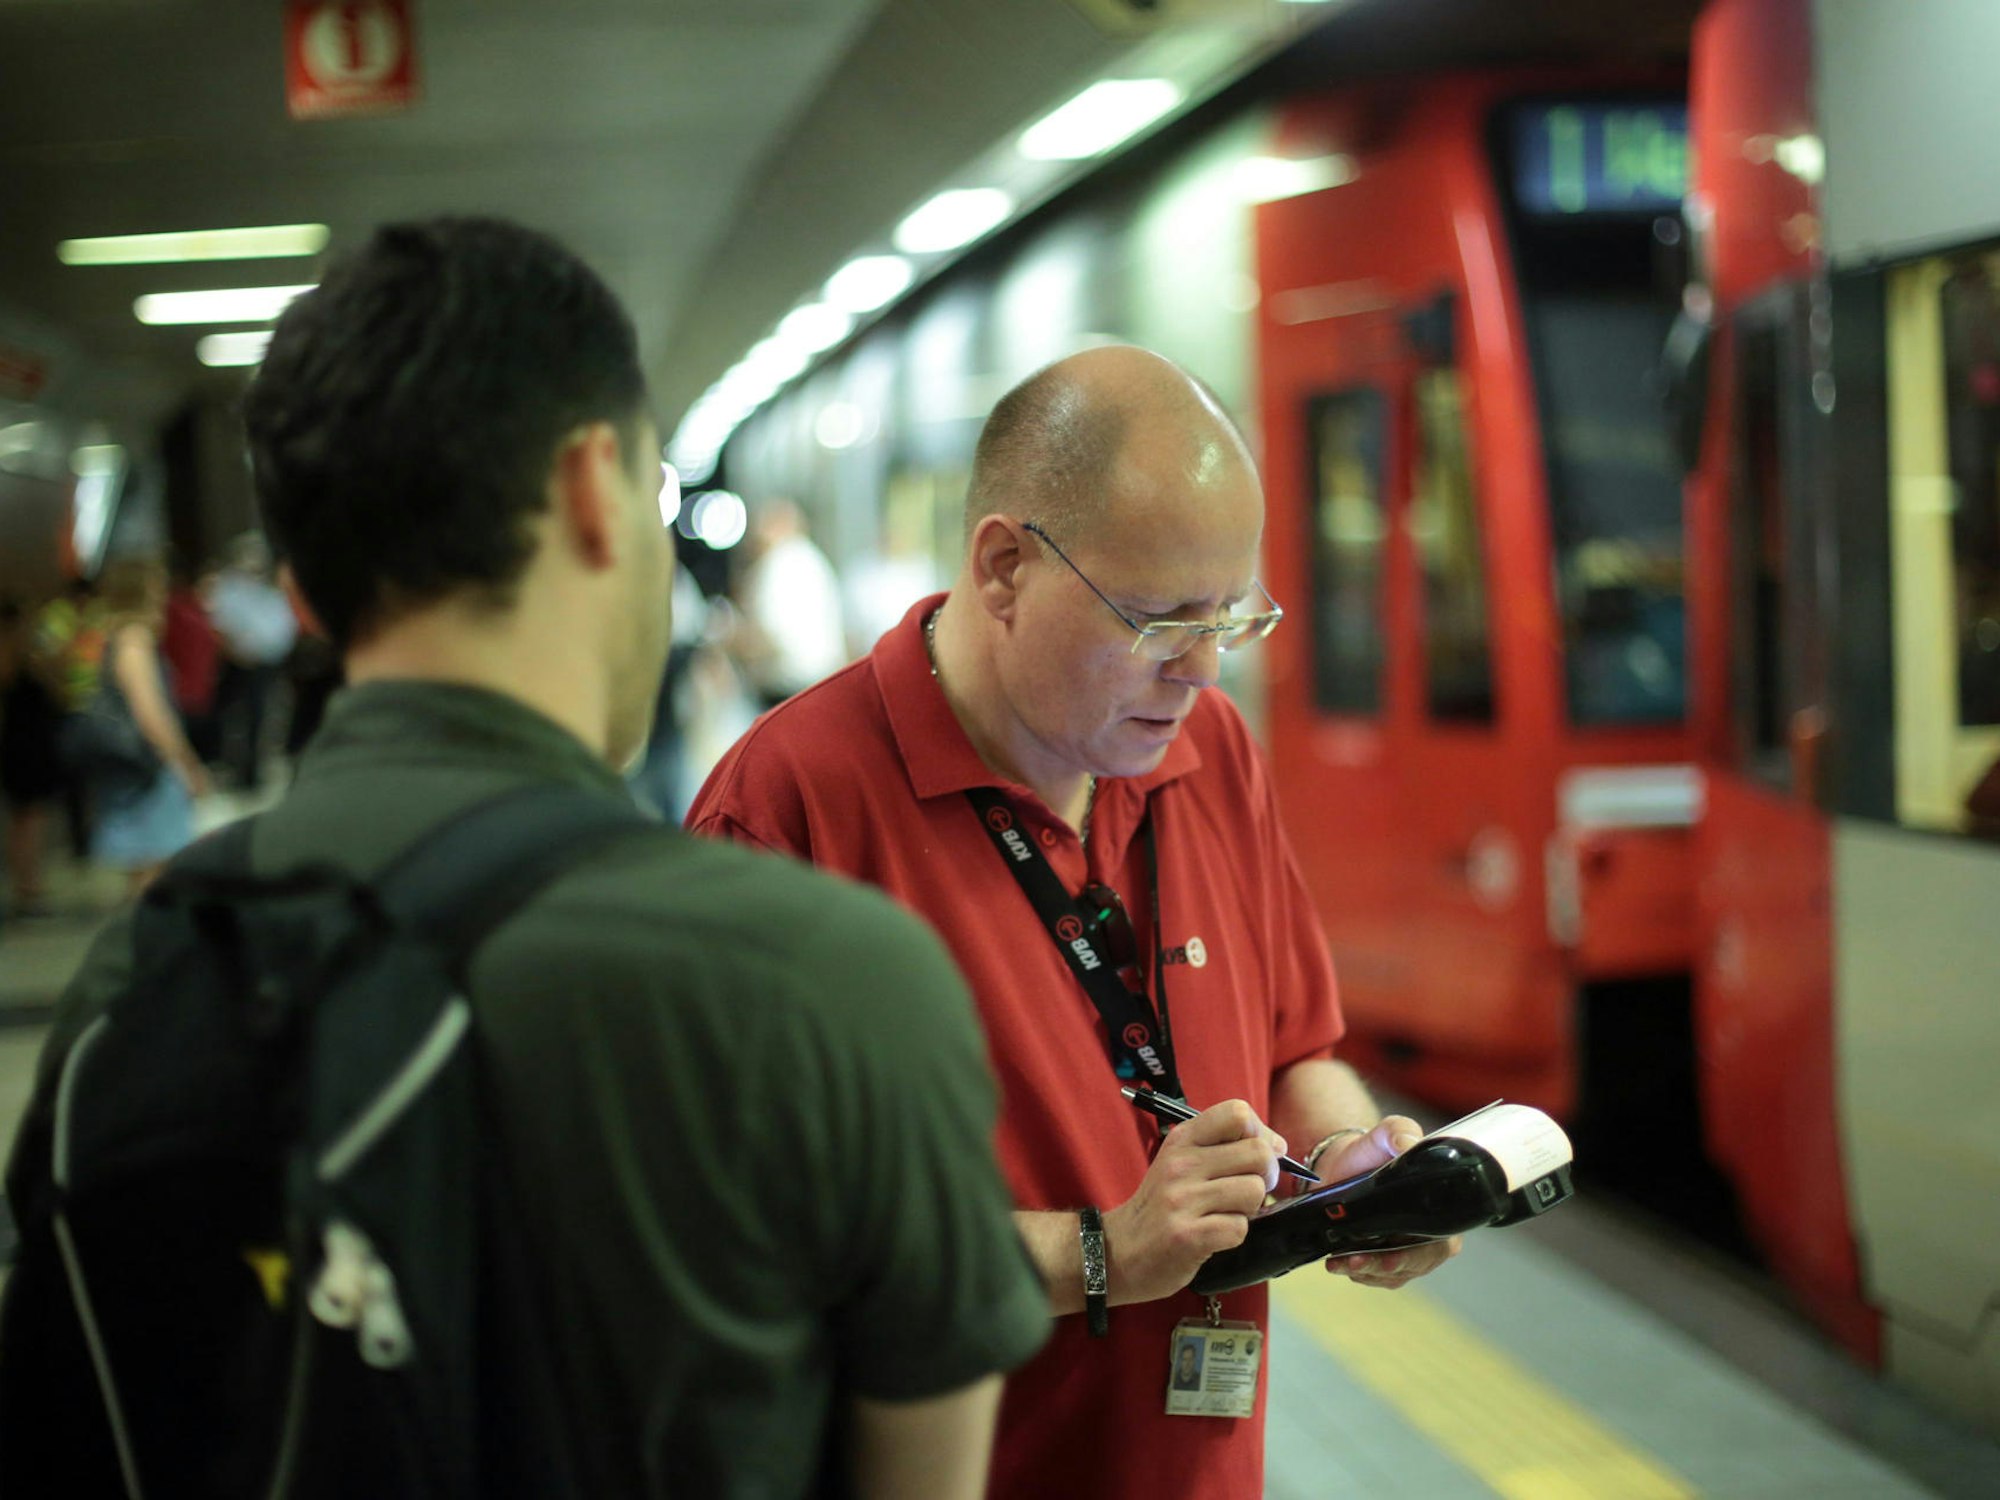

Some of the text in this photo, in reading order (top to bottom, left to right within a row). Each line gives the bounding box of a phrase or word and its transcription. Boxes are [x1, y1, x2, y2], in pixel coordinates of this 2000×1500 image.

[1002, 829, 1032, 861] KVB
[1072, 938, 1101, 970] KVB
[1138, 1045, 1166, 1076] KVB
